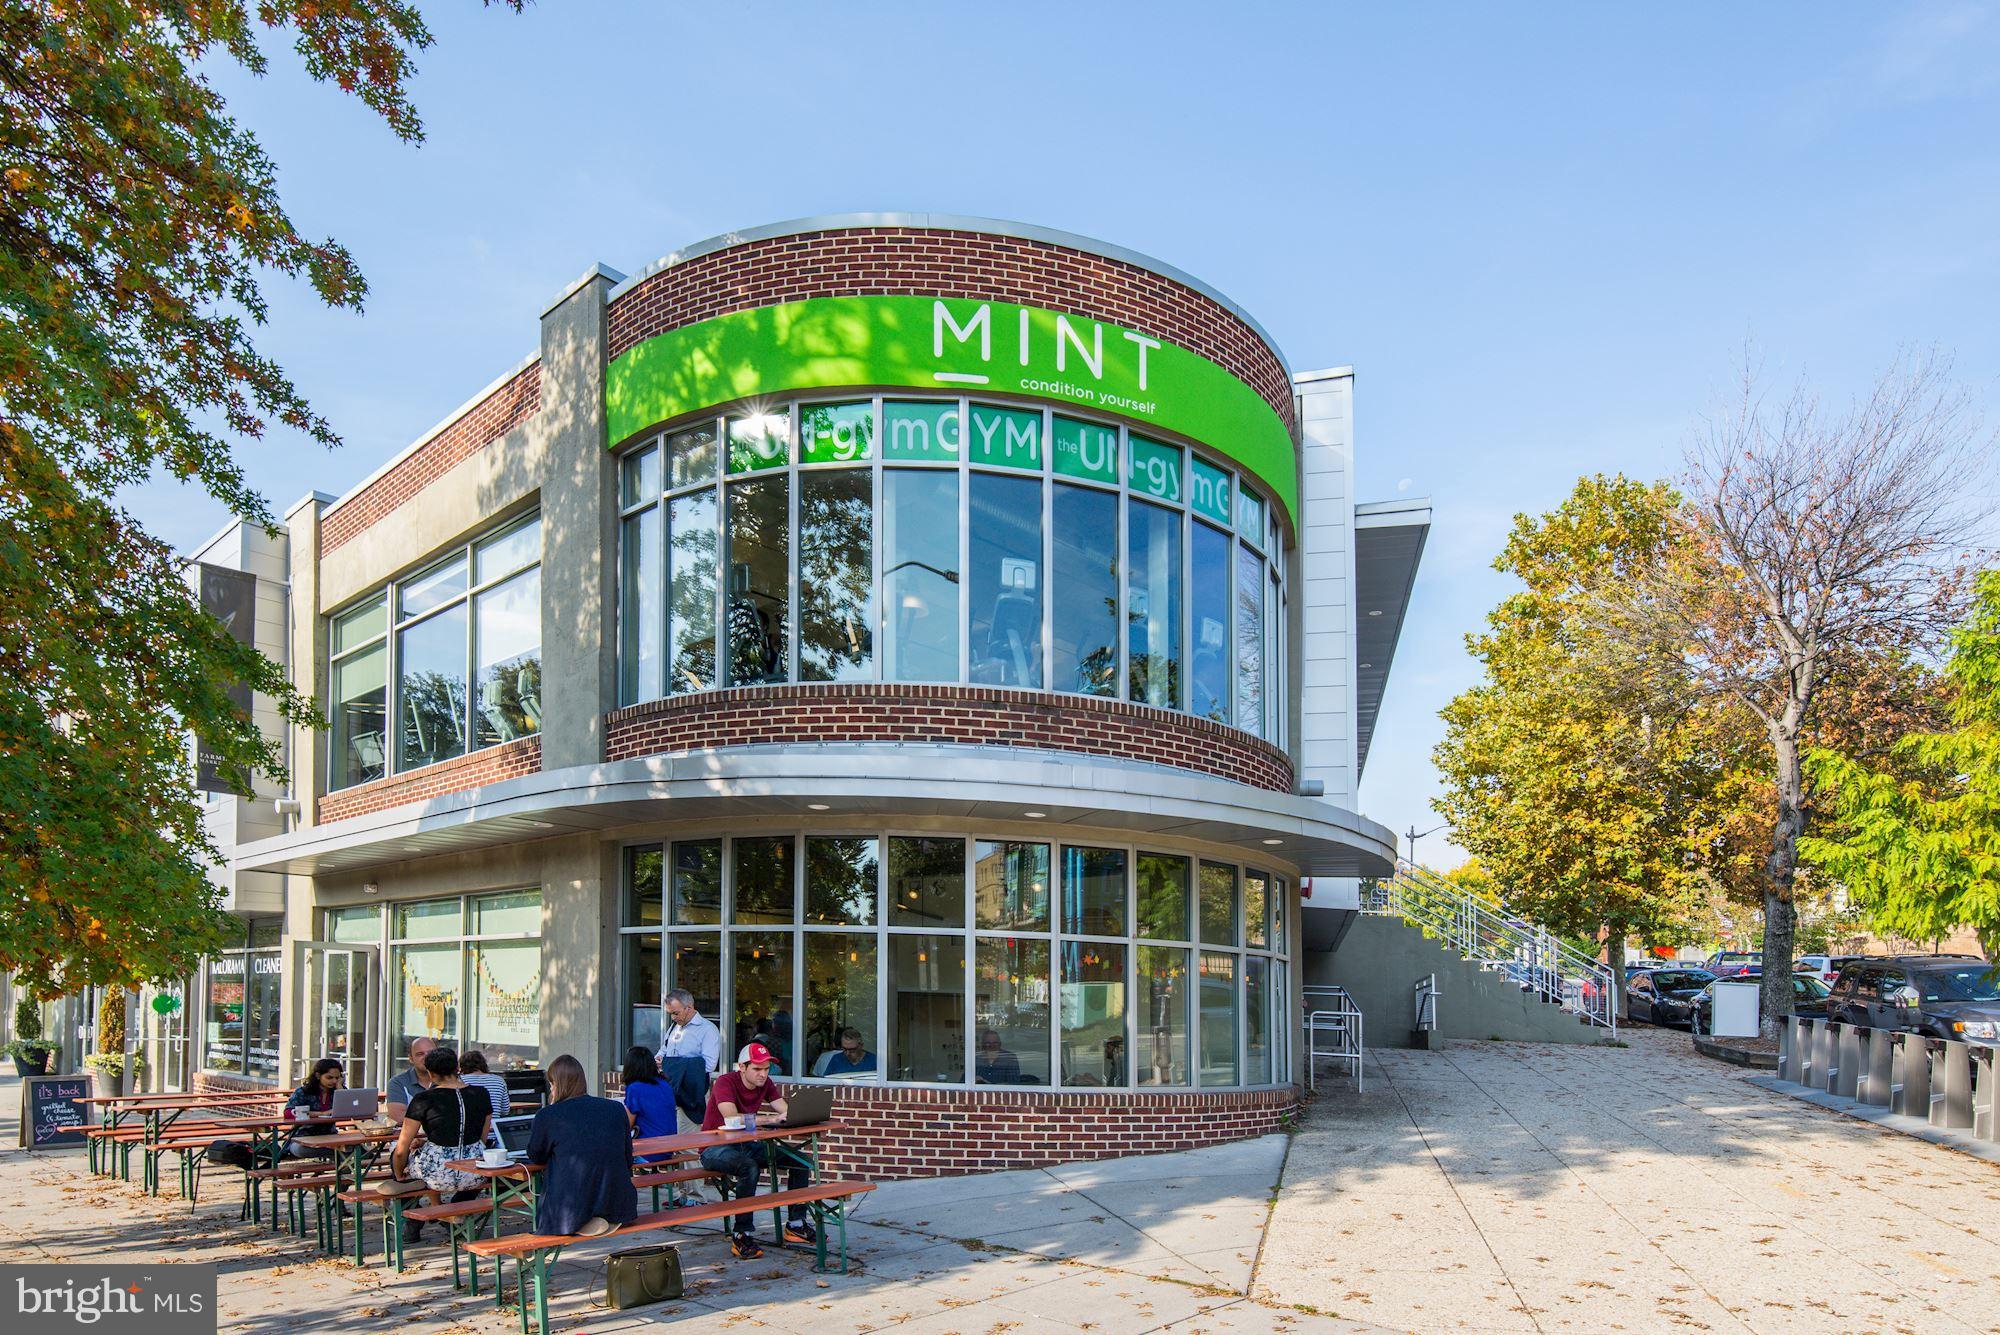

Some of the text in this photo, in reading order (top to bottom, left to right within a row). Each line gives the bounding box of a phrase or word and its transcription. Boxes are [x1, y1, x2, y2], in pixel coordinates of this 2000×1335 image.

[933, 300, 1162, 392] MINT
[1020, 378, 1156, 415] condition yourself
[1057, 437, 1078, 454] the
[254, 957, 282, 974] CLEANE
[58, 1084, 80, 1097] back
